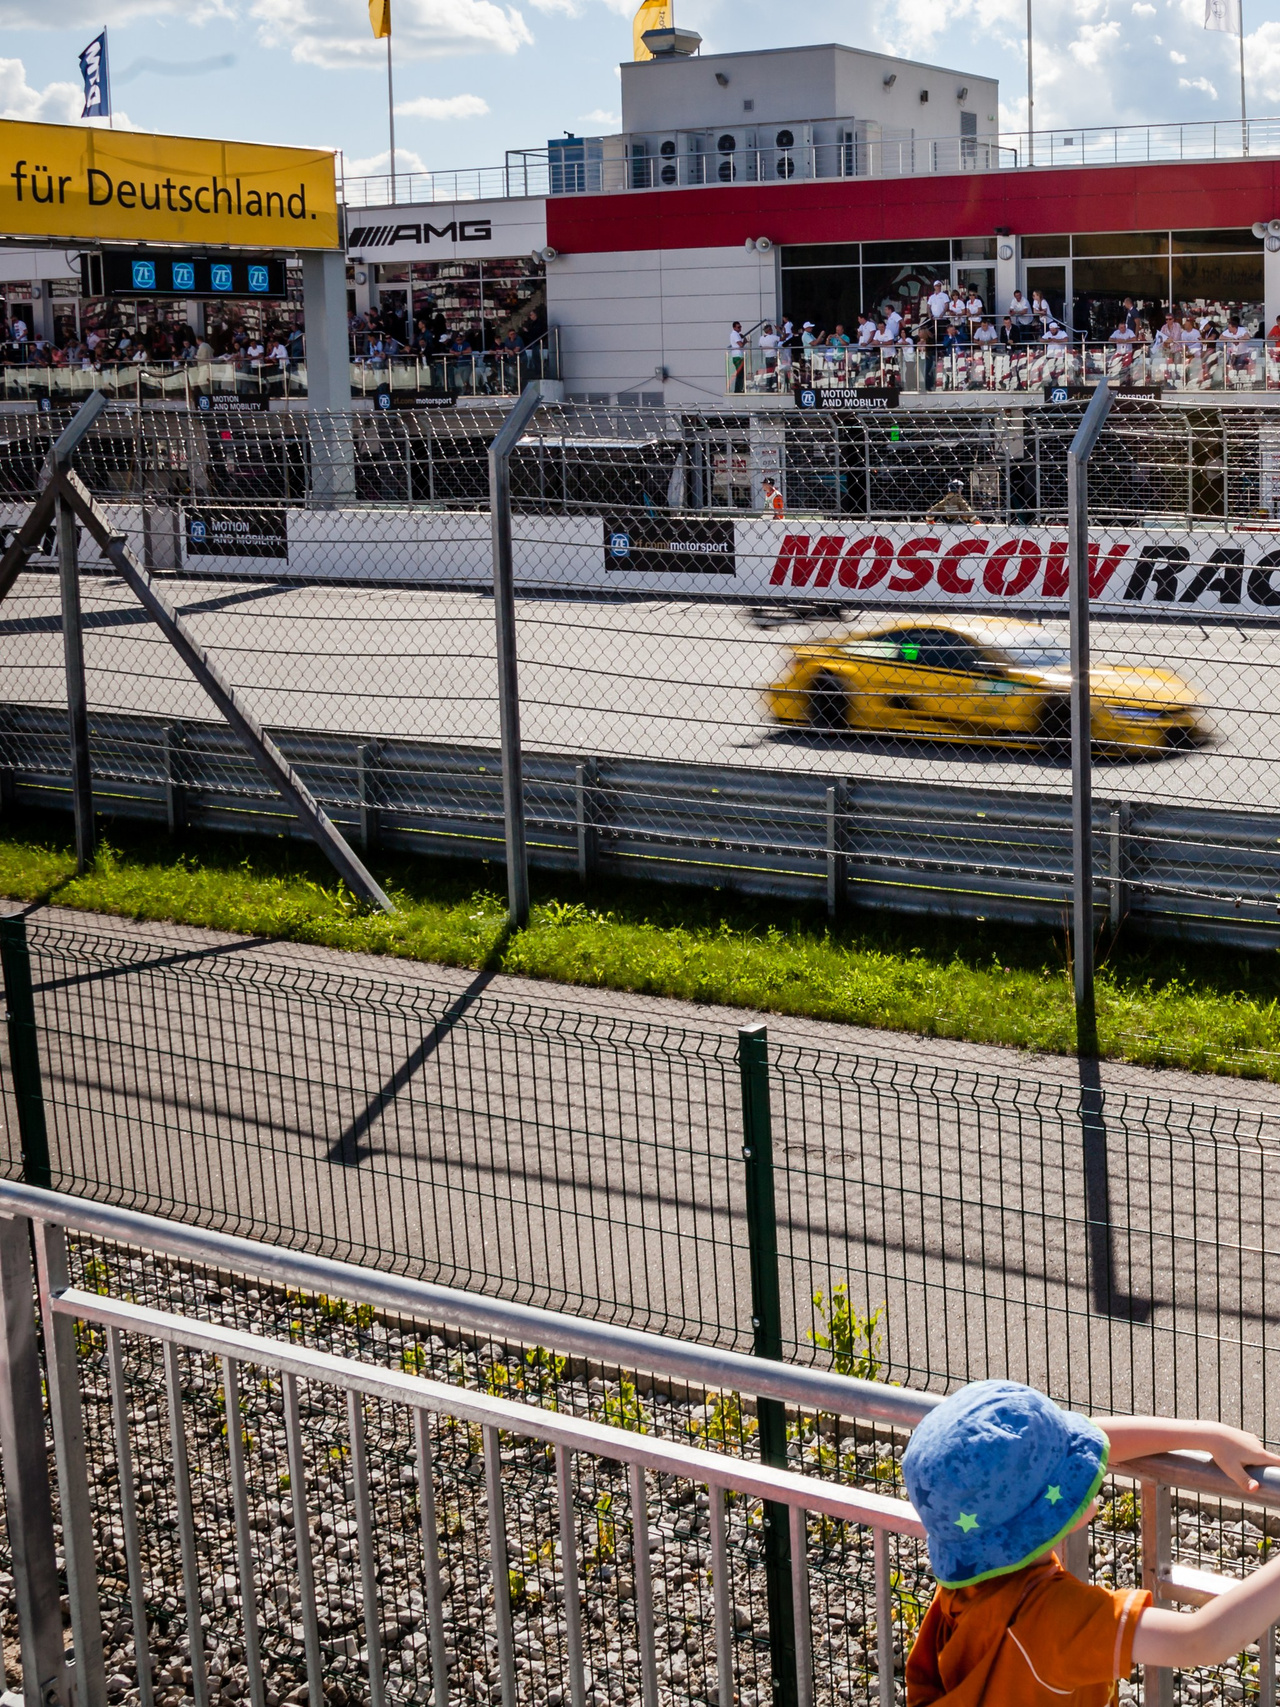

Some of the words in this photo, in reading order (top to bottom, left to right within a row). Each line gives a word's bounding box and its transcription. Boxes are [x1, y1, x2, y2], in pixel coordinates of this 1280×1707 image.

[10, 160, 72, 204] für
[87, 168, 317, 220] Deutschland.
[387, 219, 492, 246] AMG
[136, 267, 152, 282] ZF
[177, 268, 191, 283] ZF
[215, 270, 230, 284] ZF
[252, 272, 266, 285] ZF
[821, 390, 857, 398] MOTION
[822, 399, 842, 407] AND
[844, 399, 888, 408] MOBILITY
[212, 521, 249, 532] MOTION
[236, 535, 281, 546] MOBILITY
[769, 535, 1131, 599] MOSCOW
